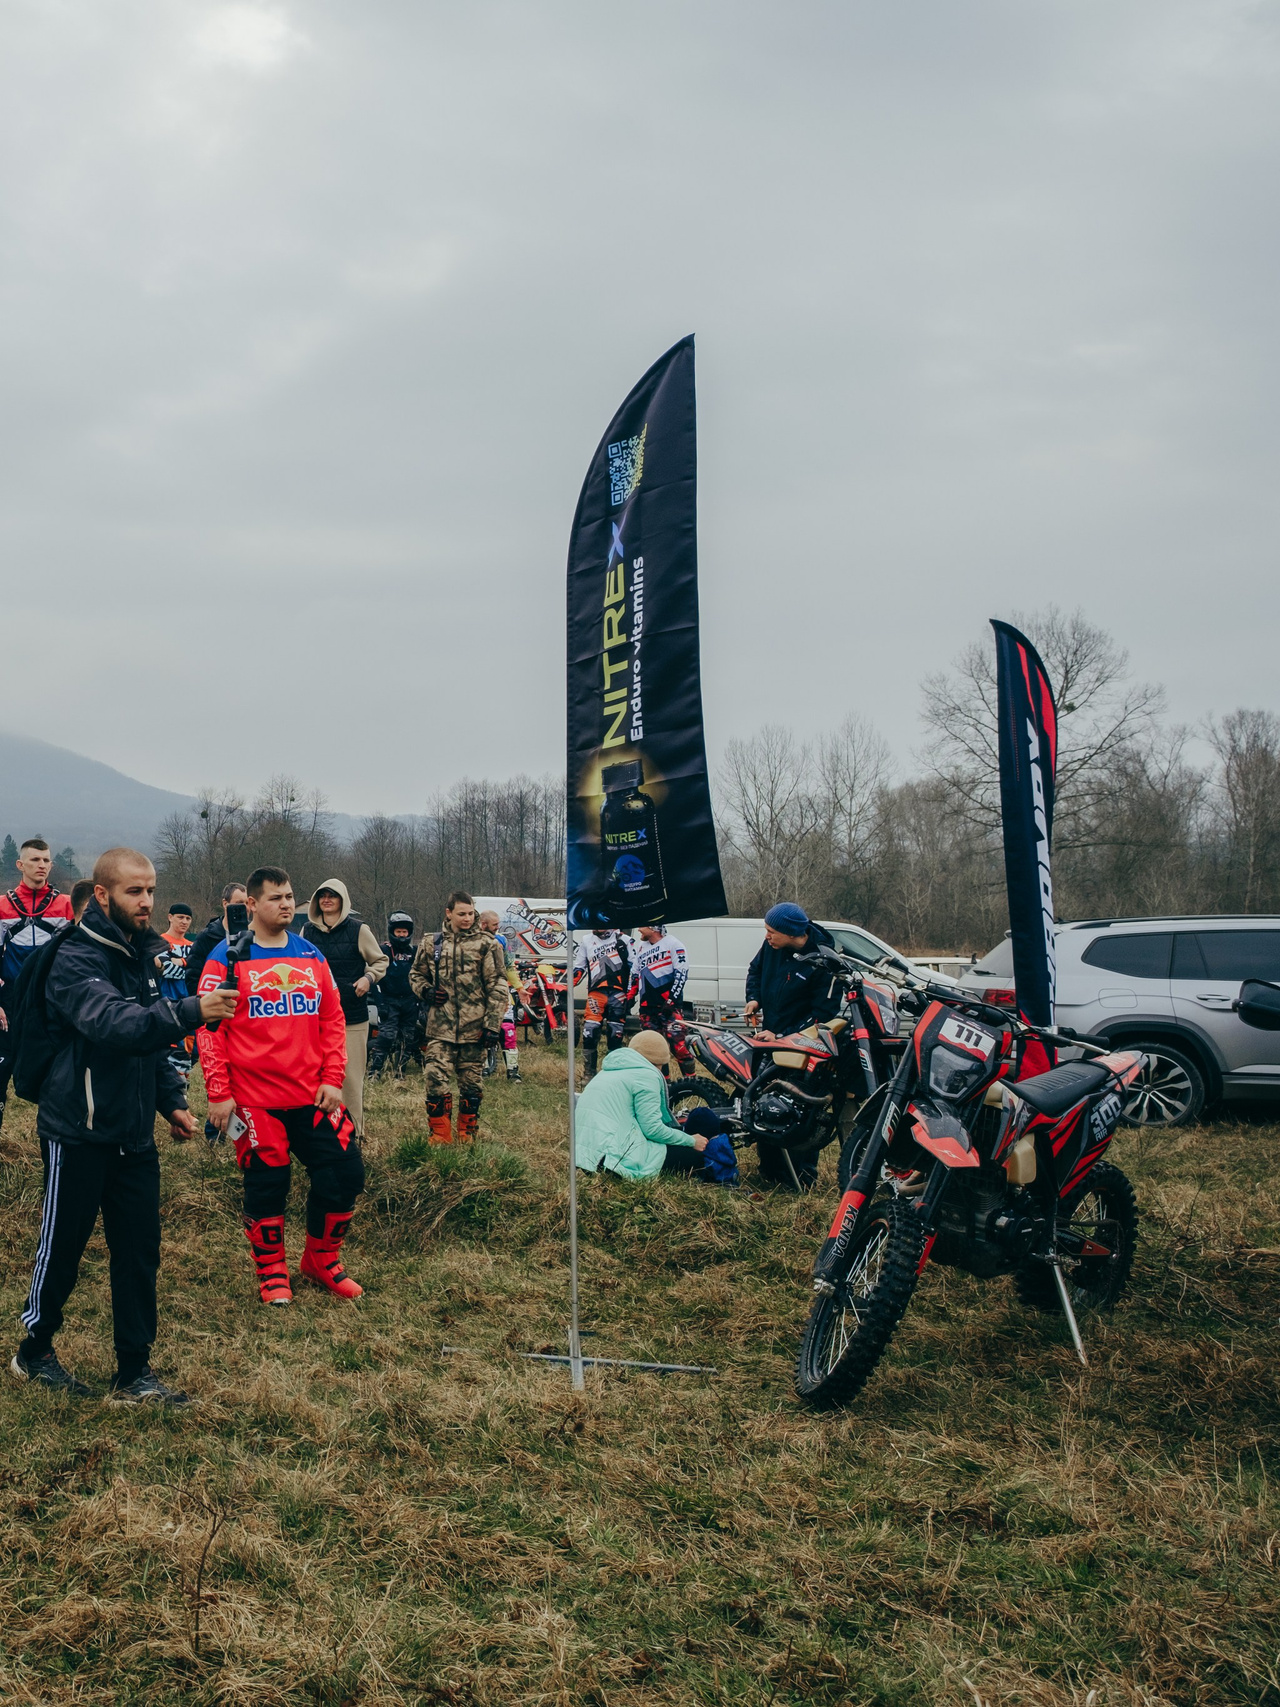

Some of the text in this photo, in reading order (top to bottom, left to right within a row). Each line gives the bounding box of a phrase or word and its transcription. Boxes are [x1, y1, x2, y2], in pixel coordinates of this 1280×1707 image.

[602, 508, 629, 749] NITREX
[629, 556, 644, 742] Enduro vitamins
[605, 828, 647, 844] NITREX
[520, 907, 553, 934] START
[249, 993, 289, 1018] Red
[714, 1029, 749, 1056] 300
[955, 1024, 983, 1048] 111
[1090, 1095, 1122, 1135] 300
[1095, 1128, 1108, 1142] AIR
[832, 1204, 859, 1258] KENDA
